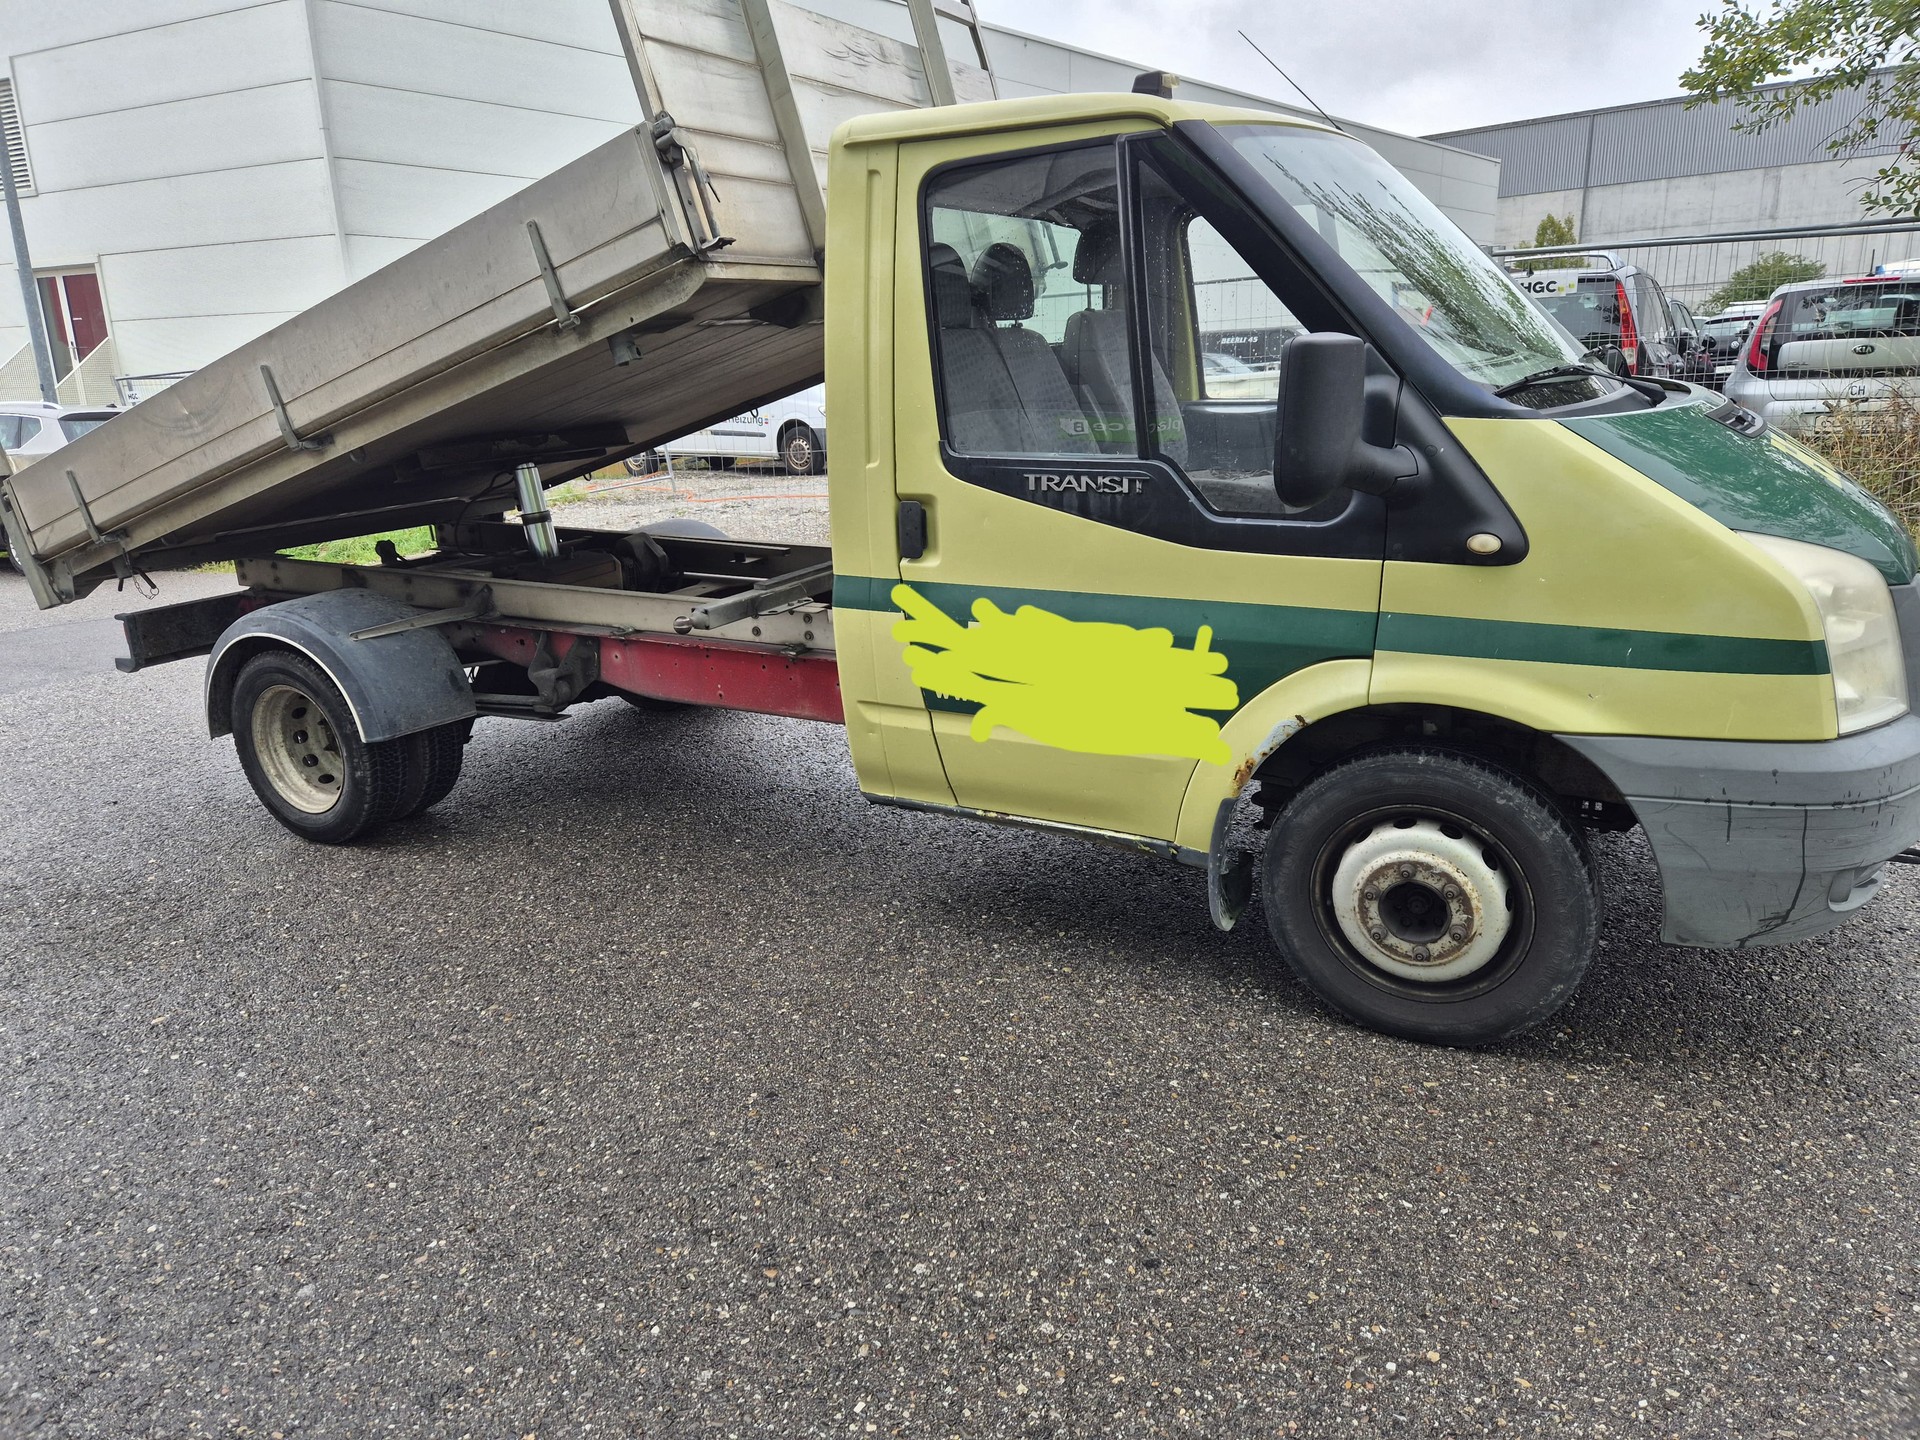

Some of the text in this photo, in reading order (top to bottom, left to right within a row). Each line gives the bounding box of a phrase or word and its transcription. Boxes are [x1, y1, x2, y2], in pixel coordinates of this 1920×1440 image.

[1520, 280, 1558, 294] HGC
[1221, 336, 1247, 345] BEERLI
[1855, 344, 1873, 355] KIA
[1850, 385, 1866, 396] CH
[1023, 473, 1150, 494] TRANSIT
